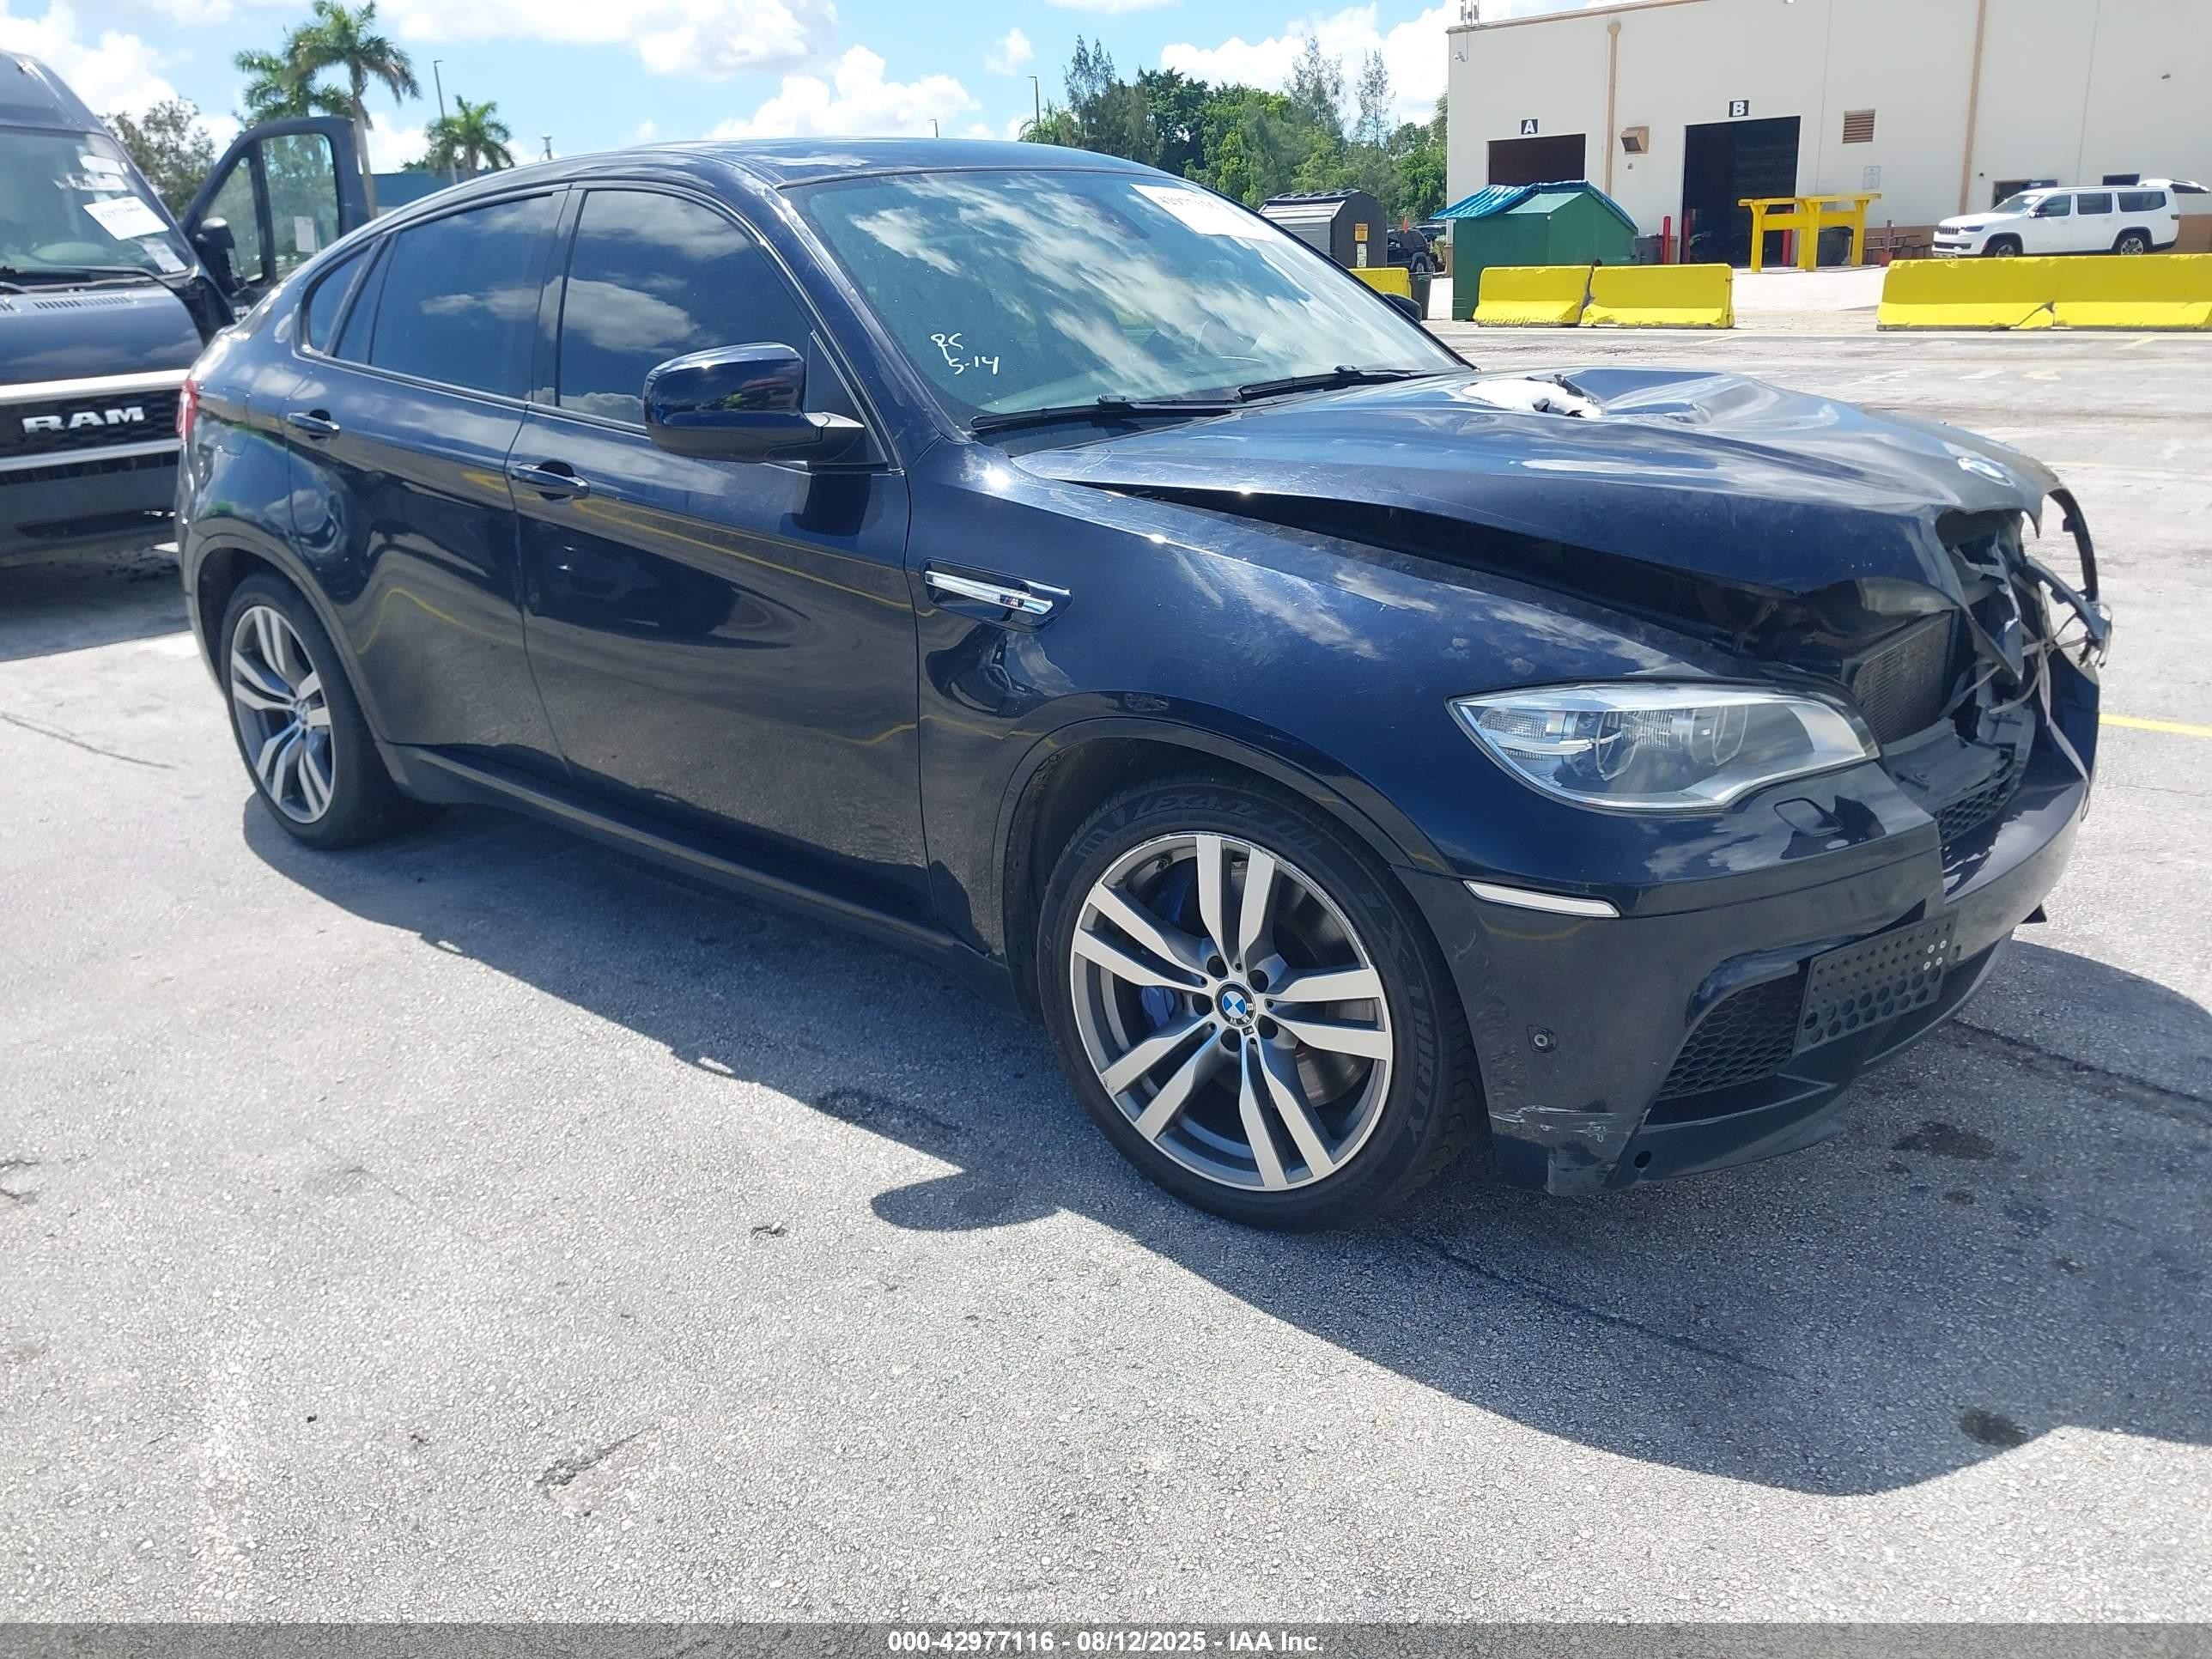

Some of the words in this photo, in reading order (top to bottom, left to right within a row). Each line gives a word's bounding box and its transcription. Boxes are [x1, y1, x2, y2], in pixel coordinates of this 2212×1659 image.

[1732, 101, 1745, 116] B
[1523, 119, 1535, 134] A
[948, 355, 1000, 375] 5-14
[21, 406, 145, 434] RAM
